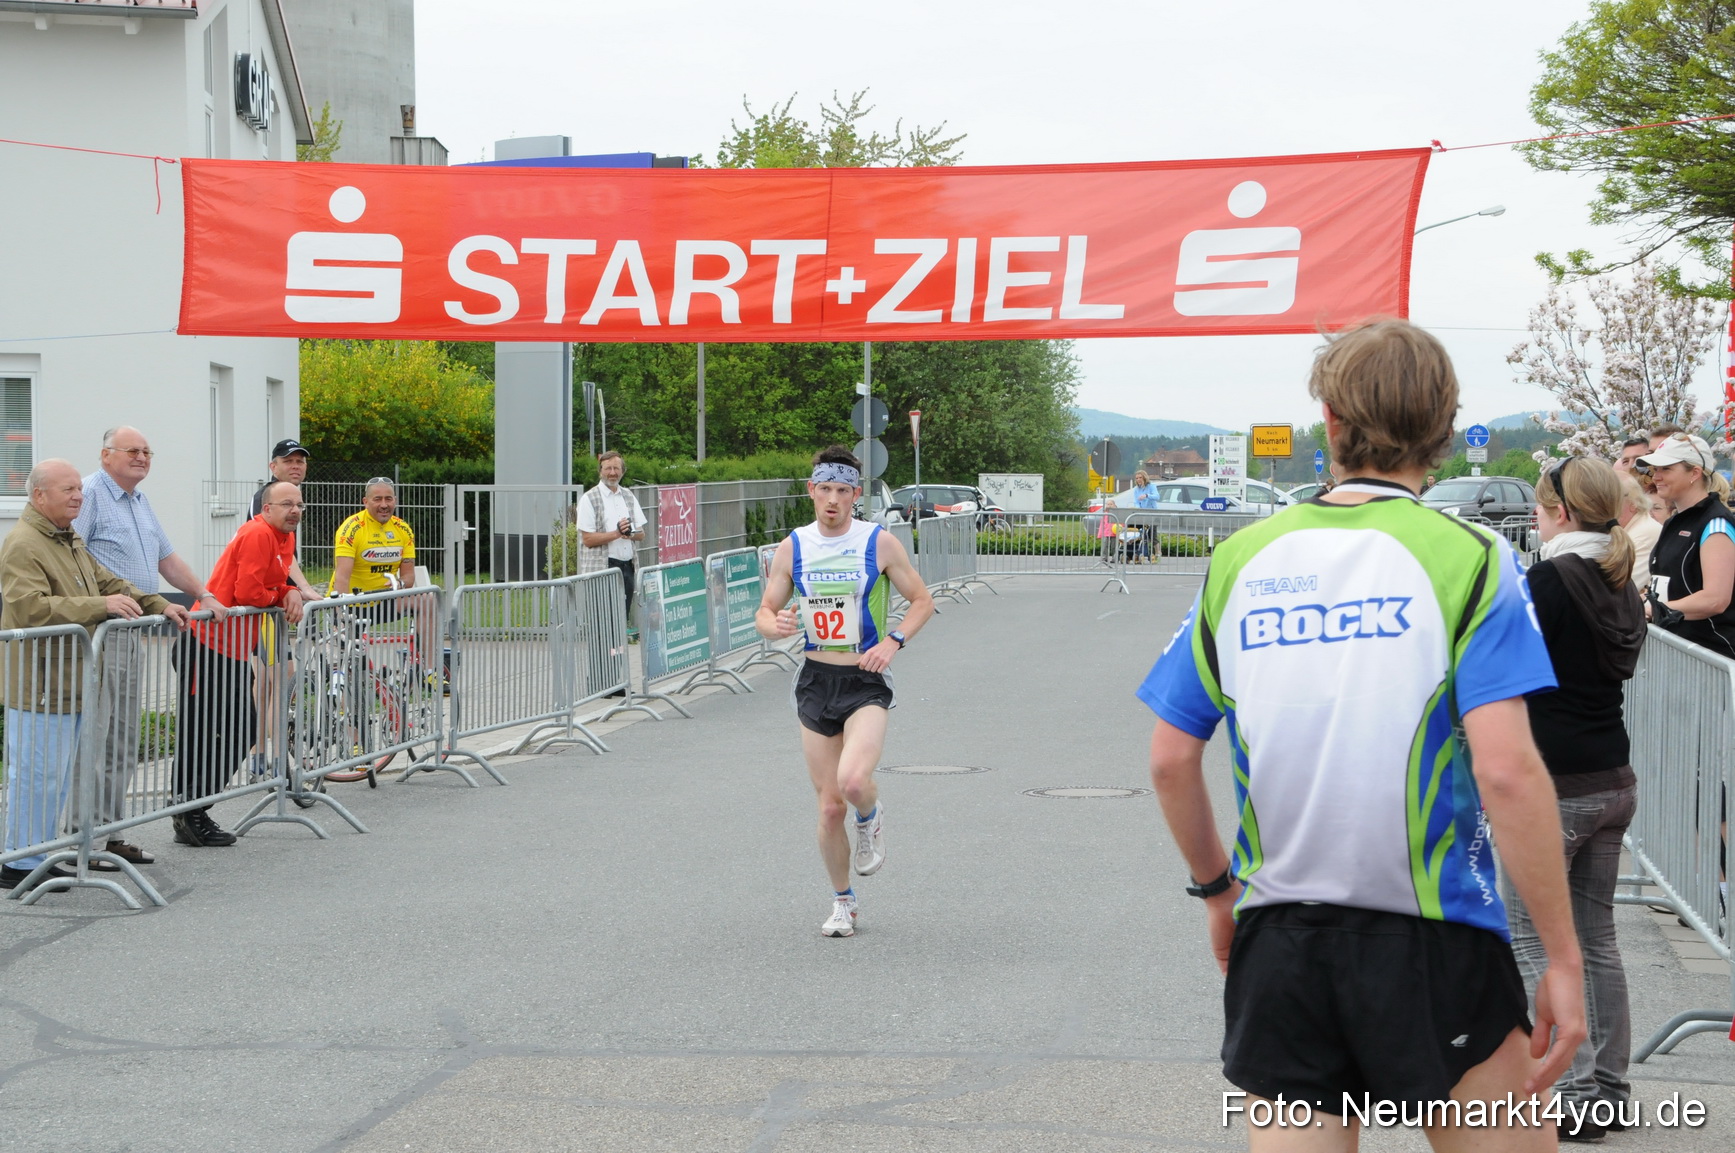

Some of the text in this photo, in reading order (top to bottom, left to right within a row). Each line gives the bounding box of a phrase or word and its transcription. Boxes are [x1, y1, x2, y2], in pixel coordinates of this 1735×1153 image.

[1256, 437, 1288, 445] Neumarkt
[1206, 502, 1224, 510] VOLVO
[665, 523, 693, 547] ZEITLOS
[363, 550, 400, 559] Mercatone
[807, 571, 861, 582] BOCK
[1246, 575, 1317, 597] TEAM
[665, 608, 674, 623] Fun
[677, 603, 689, 620] Action
[813, 610, 846, 640] 92
[1241, 597, 1413, 652] BOCK
